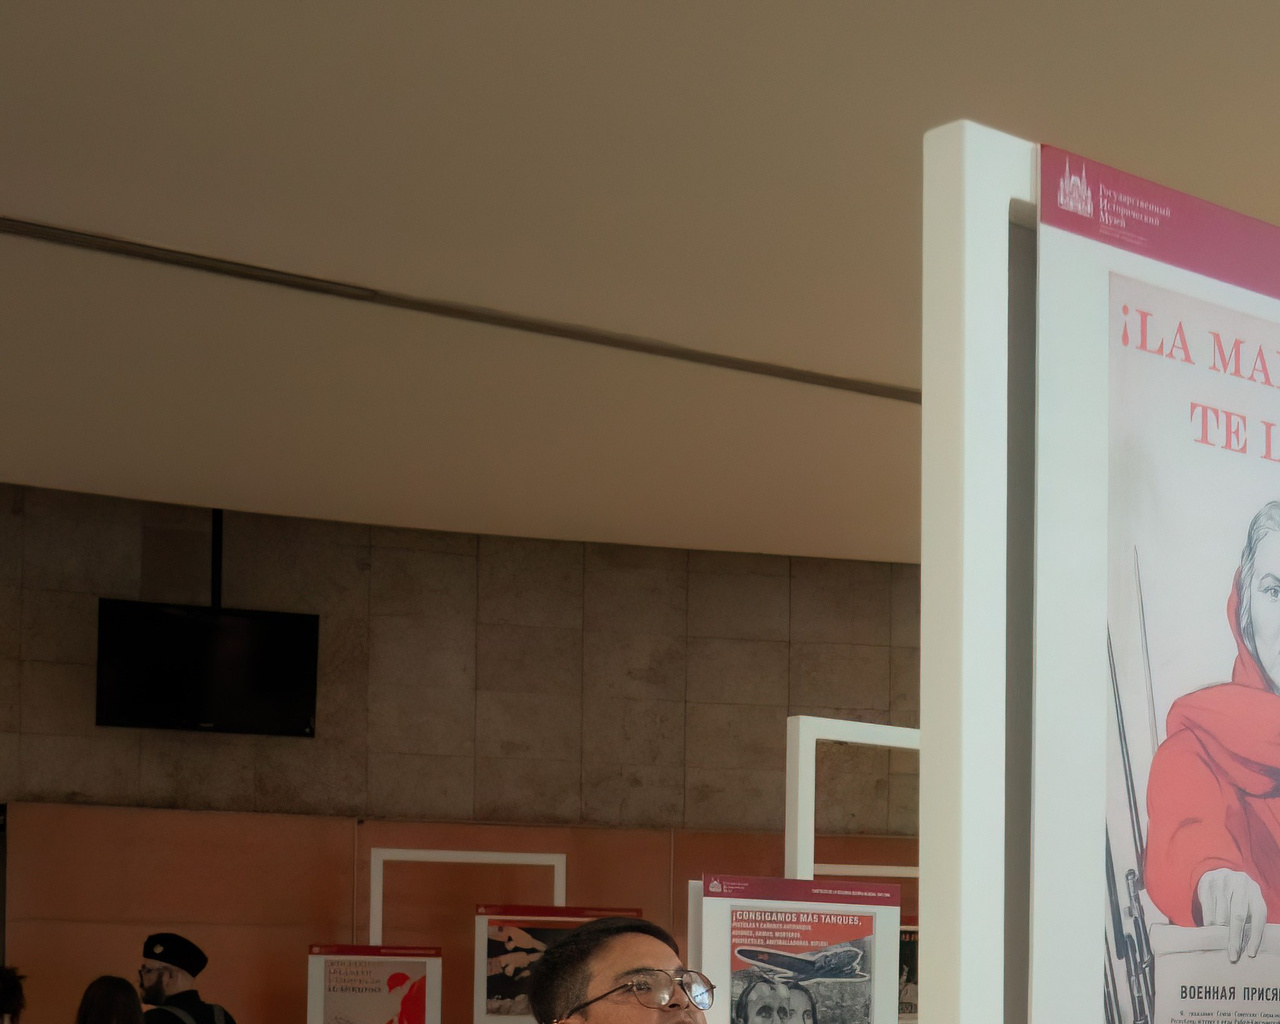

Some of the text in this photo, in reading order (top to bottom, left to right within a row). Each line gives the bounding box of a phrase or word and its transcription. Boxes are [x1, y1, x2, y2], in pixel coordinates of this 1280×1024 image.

[1121, 304, 1196, 365] ¡LA
[1190, 401, 1248, 454] TE
[732, 911, 798, 922] ¡CONSIGAMOS
[1180, 985, 1236, 1000] ВОЕННАЯ
